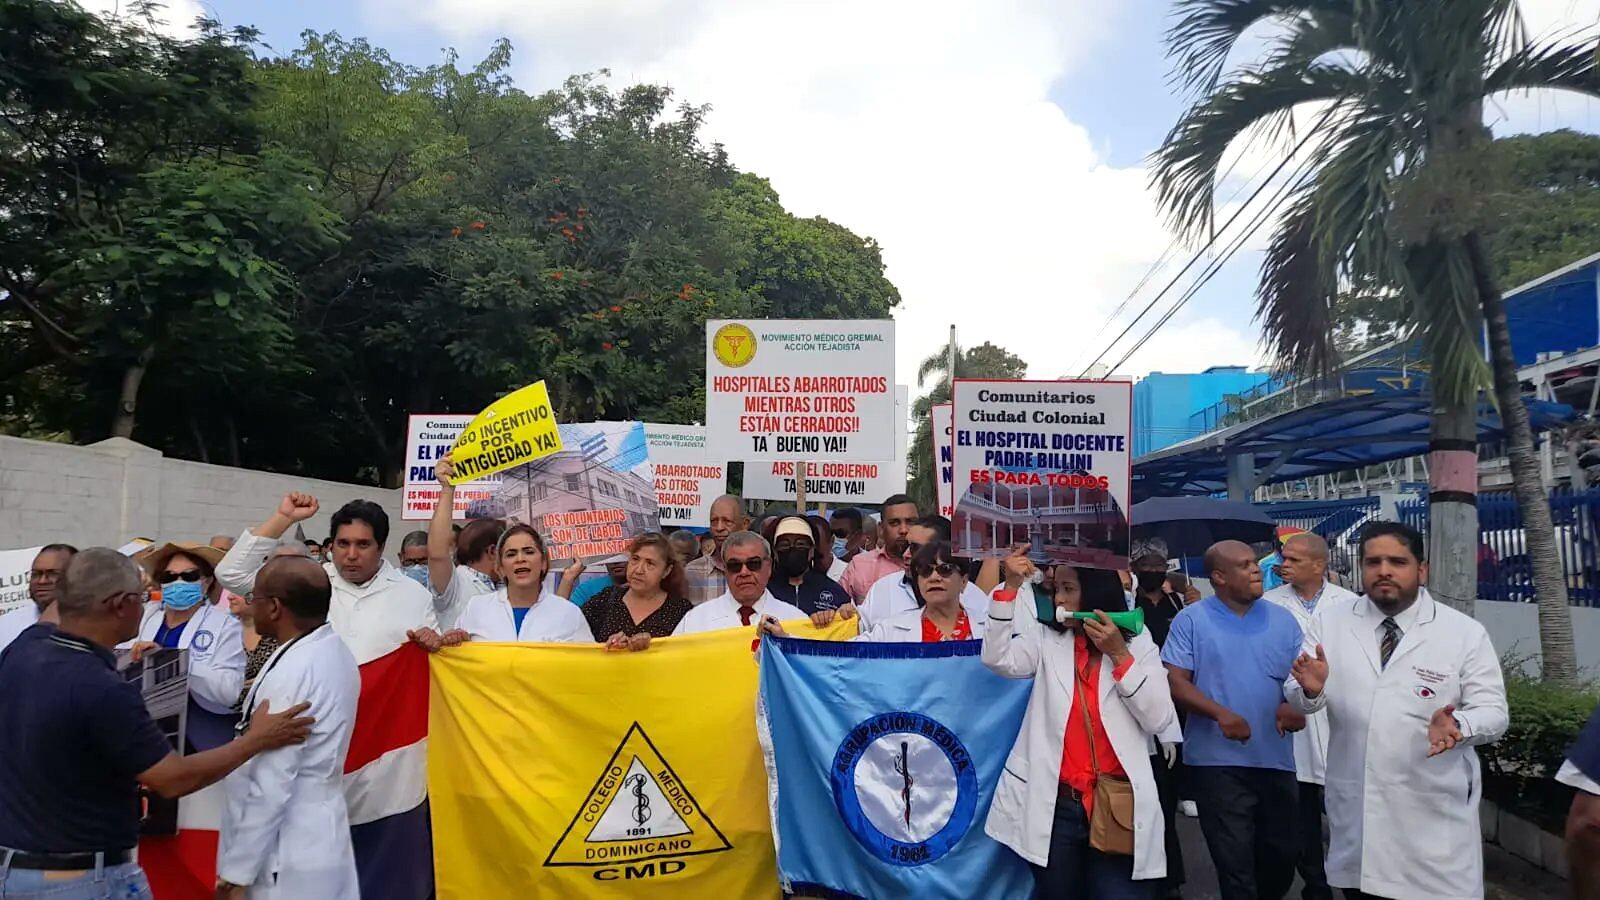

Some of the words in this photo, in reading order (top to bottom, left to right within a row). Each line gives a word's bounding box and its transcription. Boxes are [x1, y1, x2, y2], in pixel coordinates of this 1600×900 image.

[761, 334, 812, 342] MOVIMIENTO
[847, 334, 883, 342] GREMIAL
[817, 343, 860, 351] TEJADISTA
[713, 376, 790, 393] HOSPITALES
[793, 377, 887, 393] ABARROTADOS
[744, 397, 810, 413] MIENTRAS
[814, 397, 855, 412] OTROS
[978, 390, 1096, 404] Comunitarios
[480, 405, 548, 439] INCENTIVO
[740, 412, 780, 433] ESTÁN
[784, 417, 860, 433] CERRADOS!!
[968, 410, 1026, 424] Ciudad
[1032, 411, 1106, 425] Colonial
[419, 432, 456, 440] Ciudad
[480, 432, 514, 451] POR
[533, 431, 557, 452] YA!
[776, 436, 819, 452] BUENO
[823, 436, 847, 452] YA!!
[957, 430, 972, 446] EL
[975, 431, 1046, 449] HOSPITAL
[1052, 433, 1125, 452] DOCENTE
[418, 445, 432, 460] EL
[985, 450, 1033, 467] PADRE
[1037, 452, 1093, 471] BILLINI
[410, 466, 437, 481] PAD
[655, 464, 722, 479] ABARROTADOS
[772, 461, 794, 476] ARS
[807, 463, 820, 477] EL
[822, 464, 878, 479] GOBIERNO
[669, 479, 699, 492] OTROS
[970, 470, 990, 483] ES
[994, 471, 1042, 486] PARA
[1047, 474, 1109, 489] TODOS
[844, 481, 865, 495] YA!!
[413, 503, 431, 511] PARA
[674, 507, 692, 520] YA!!
[543, 514, 561, 527] LOS
[562, 508, 626, 525] VOLUNTARIOS
[553, 529, 573, 543] SON
[576, 527, 588, 541] DE
[591, 524, 622, 539] LABOR
[584, 766, 622, 823] COLEGIO
[657, 770, 693, 816] MEDICO
[626, 827, 652, 836] 1891
[586, 839, 692, 859] DOMINICANO
[593, 860, 686, 881] CMD
